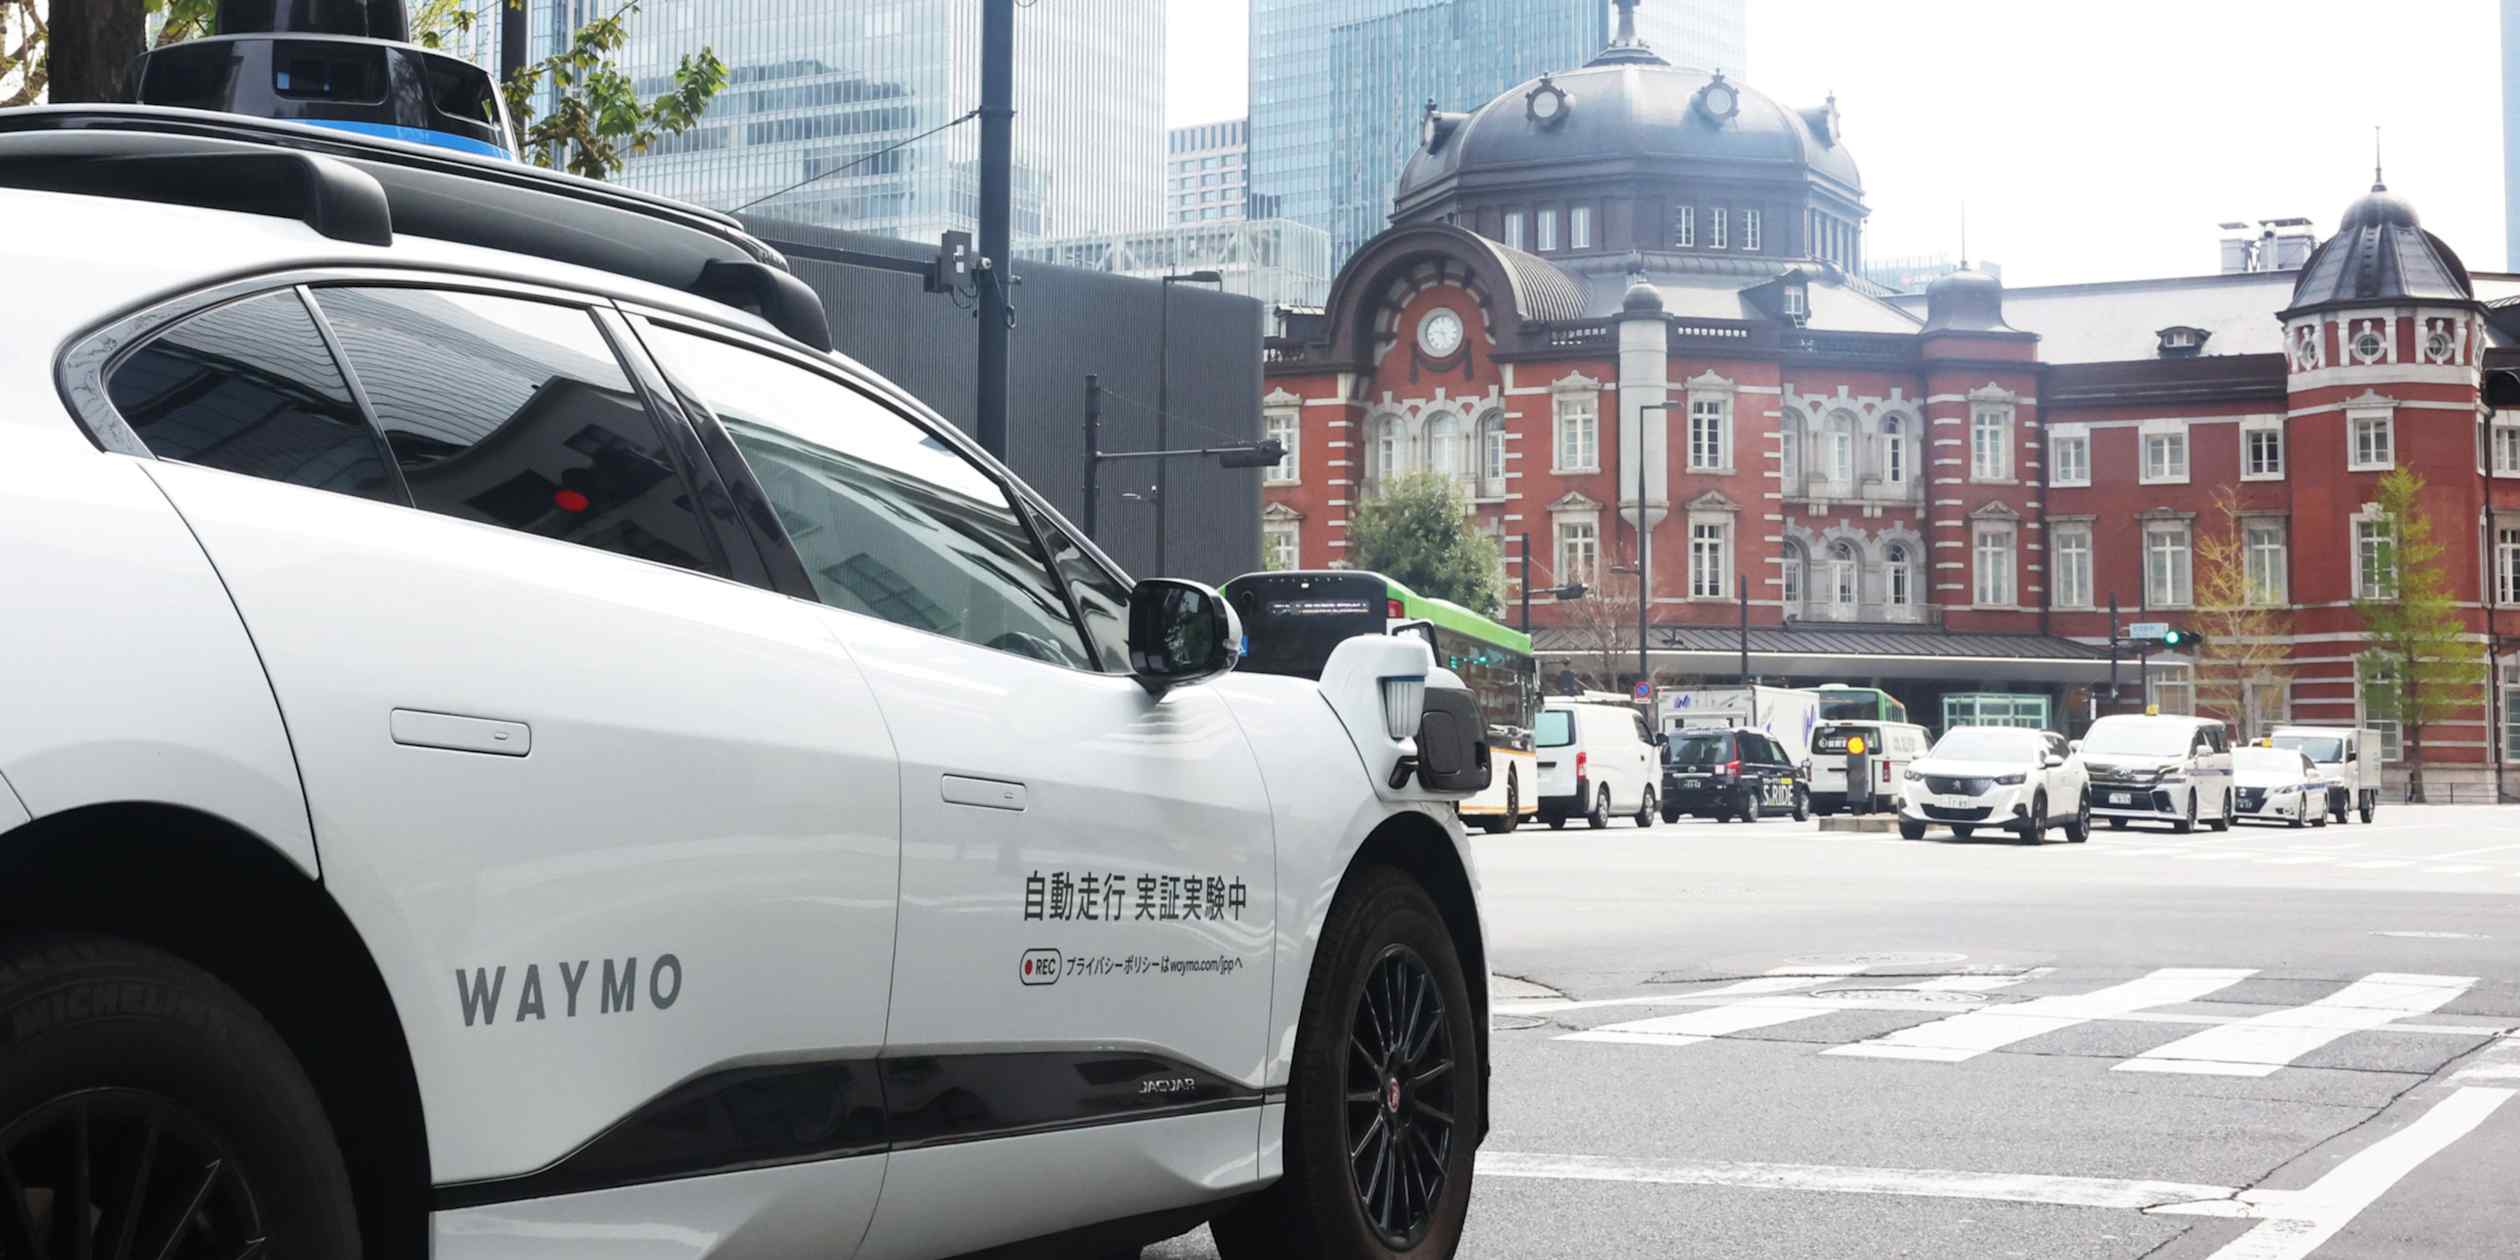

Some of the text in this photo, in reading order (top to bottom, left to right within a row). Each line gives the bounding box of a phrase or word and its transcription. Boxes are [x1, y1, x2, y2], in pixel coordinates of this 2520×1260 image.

[1024, 870, 1247, 921] 自動走行 実証実験中
[1035, 958, 1056, 976] REC
[455, 953, 683, 1027] WAYMO
[1138, 1078, 1195, 1094] JAGUAR
